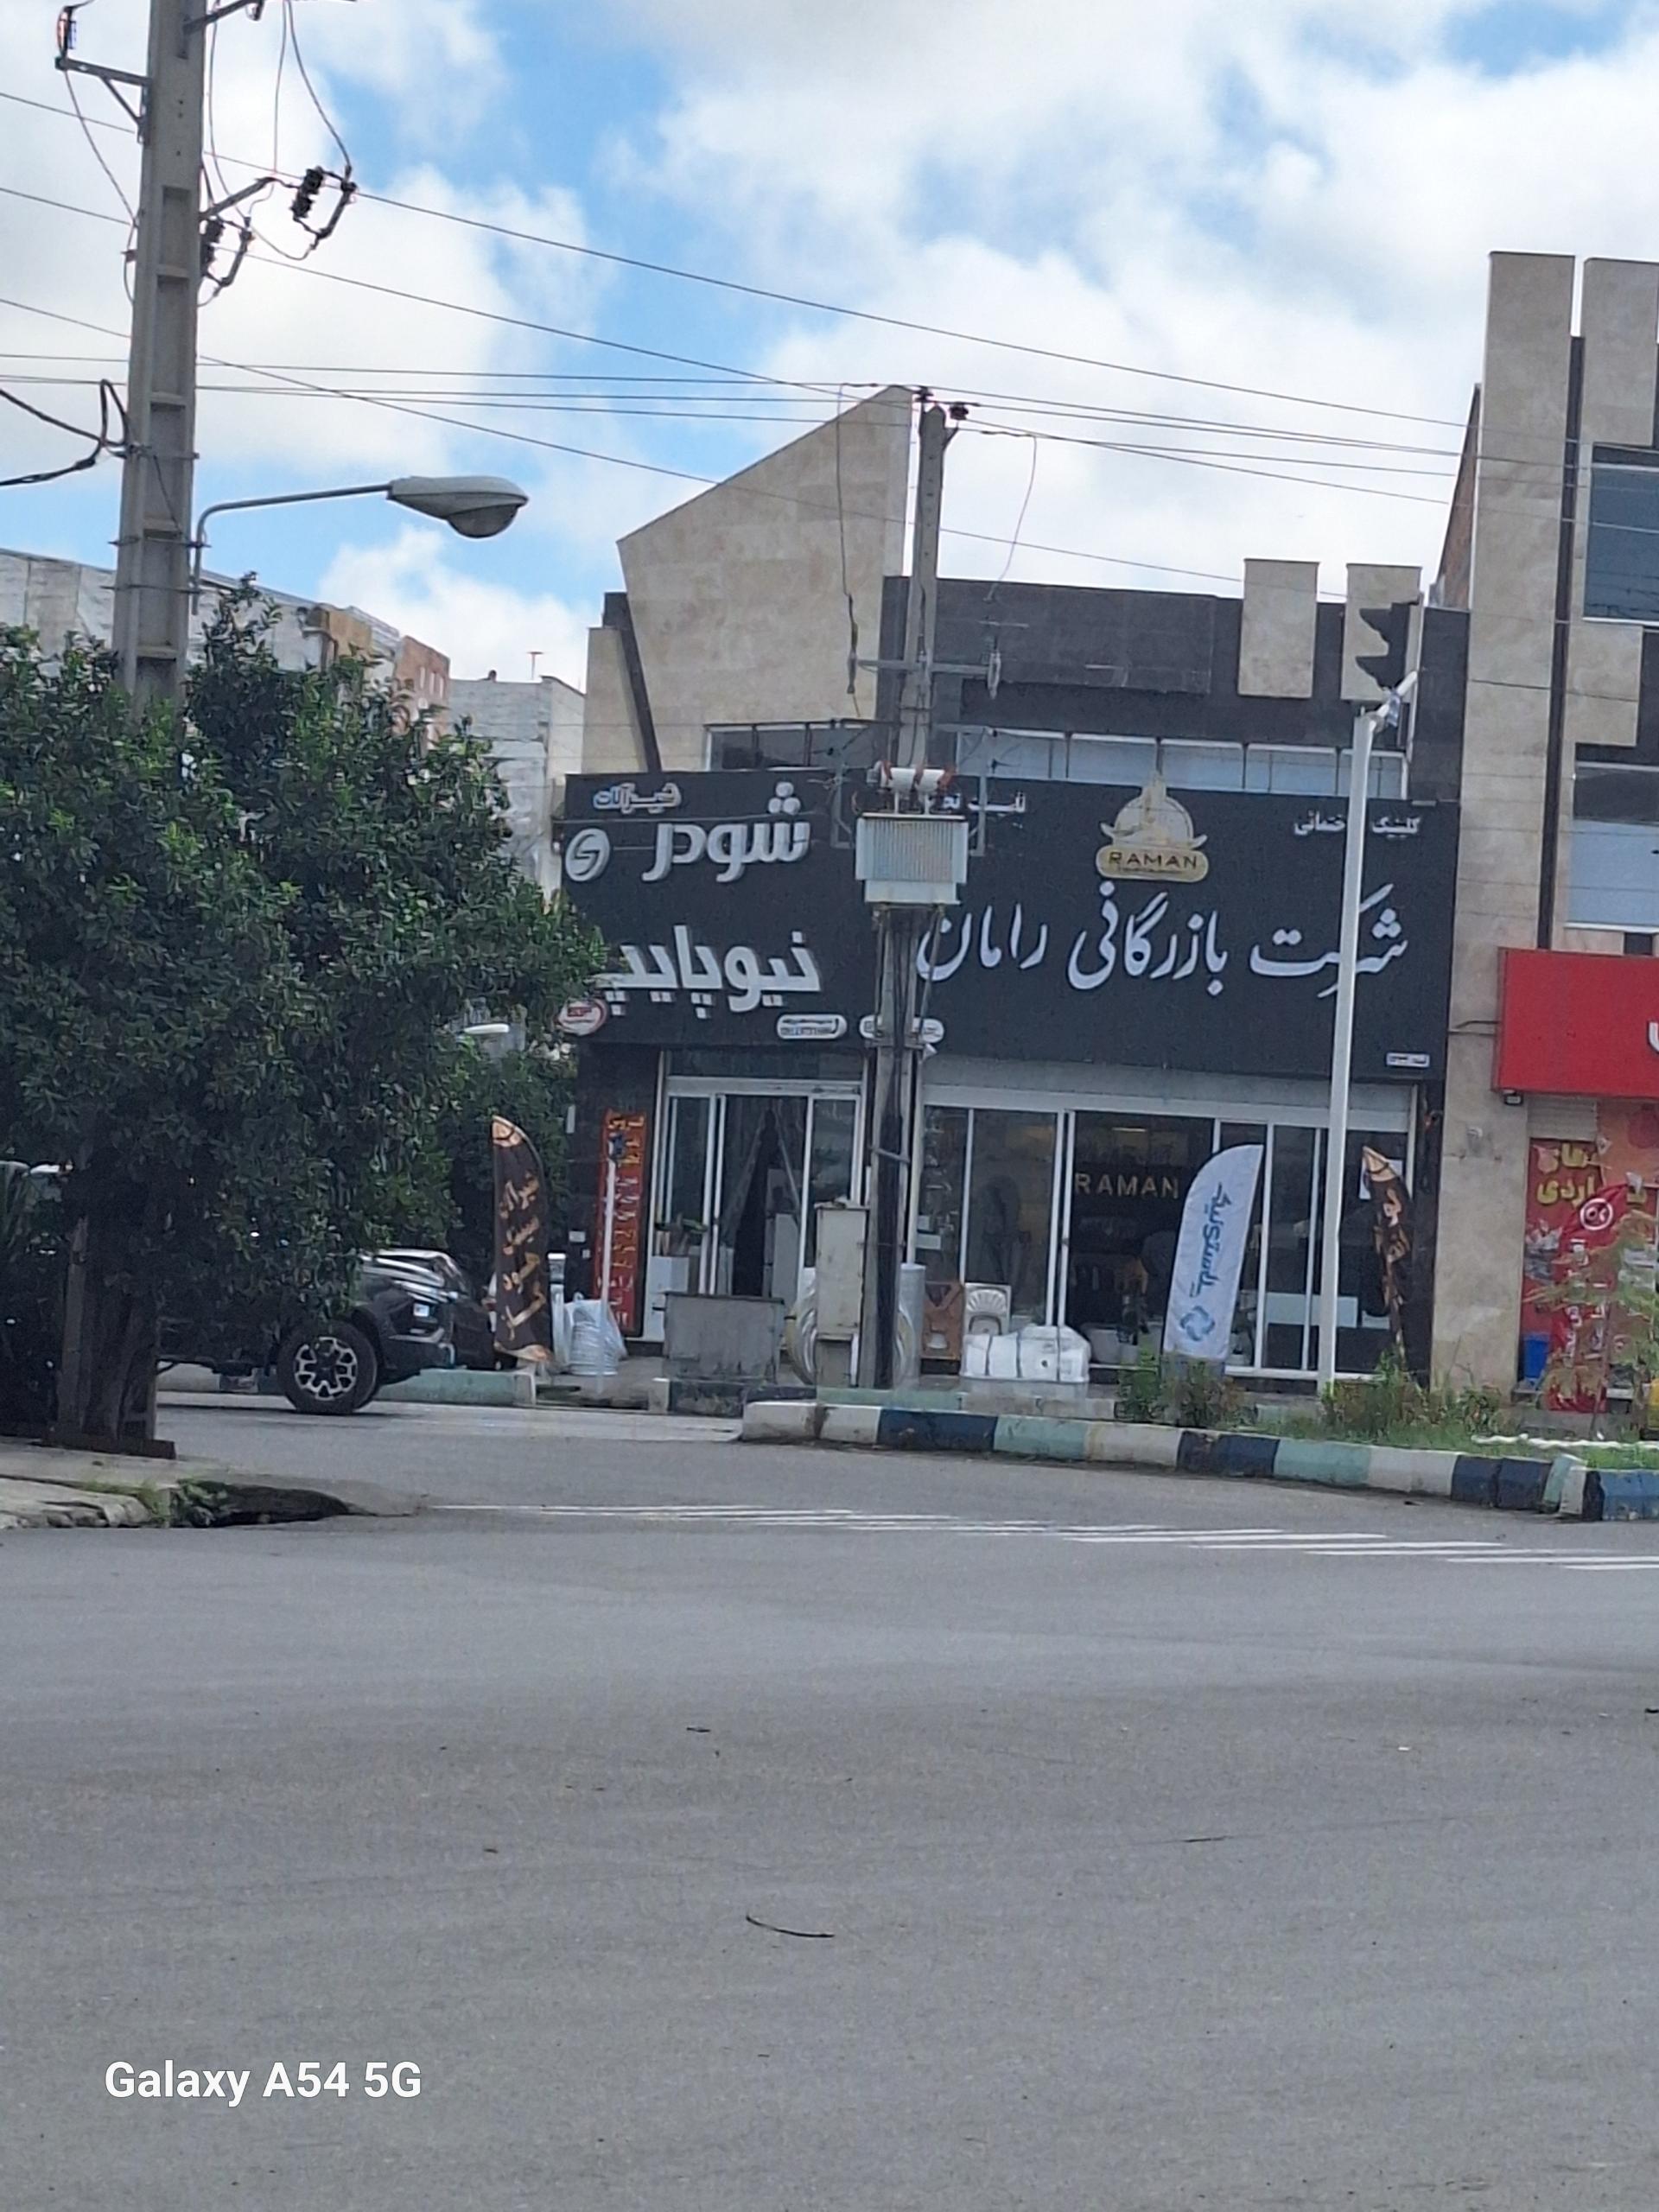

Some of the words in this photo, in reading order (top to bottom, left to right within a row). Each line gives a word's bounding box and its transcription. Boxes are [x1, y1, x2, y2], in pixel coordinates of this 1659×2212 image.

[642, 781, 810, 882] شودر
[1109, 851, 1198, 871] RAMAN
[593, 924, 821, 1020] نیوپایپ
[916, 903, 1048, 982] رامان
[1068, 880, 1228, 995] بازرگانی
[1074, 1173, 1179, 1199] RAMAN
